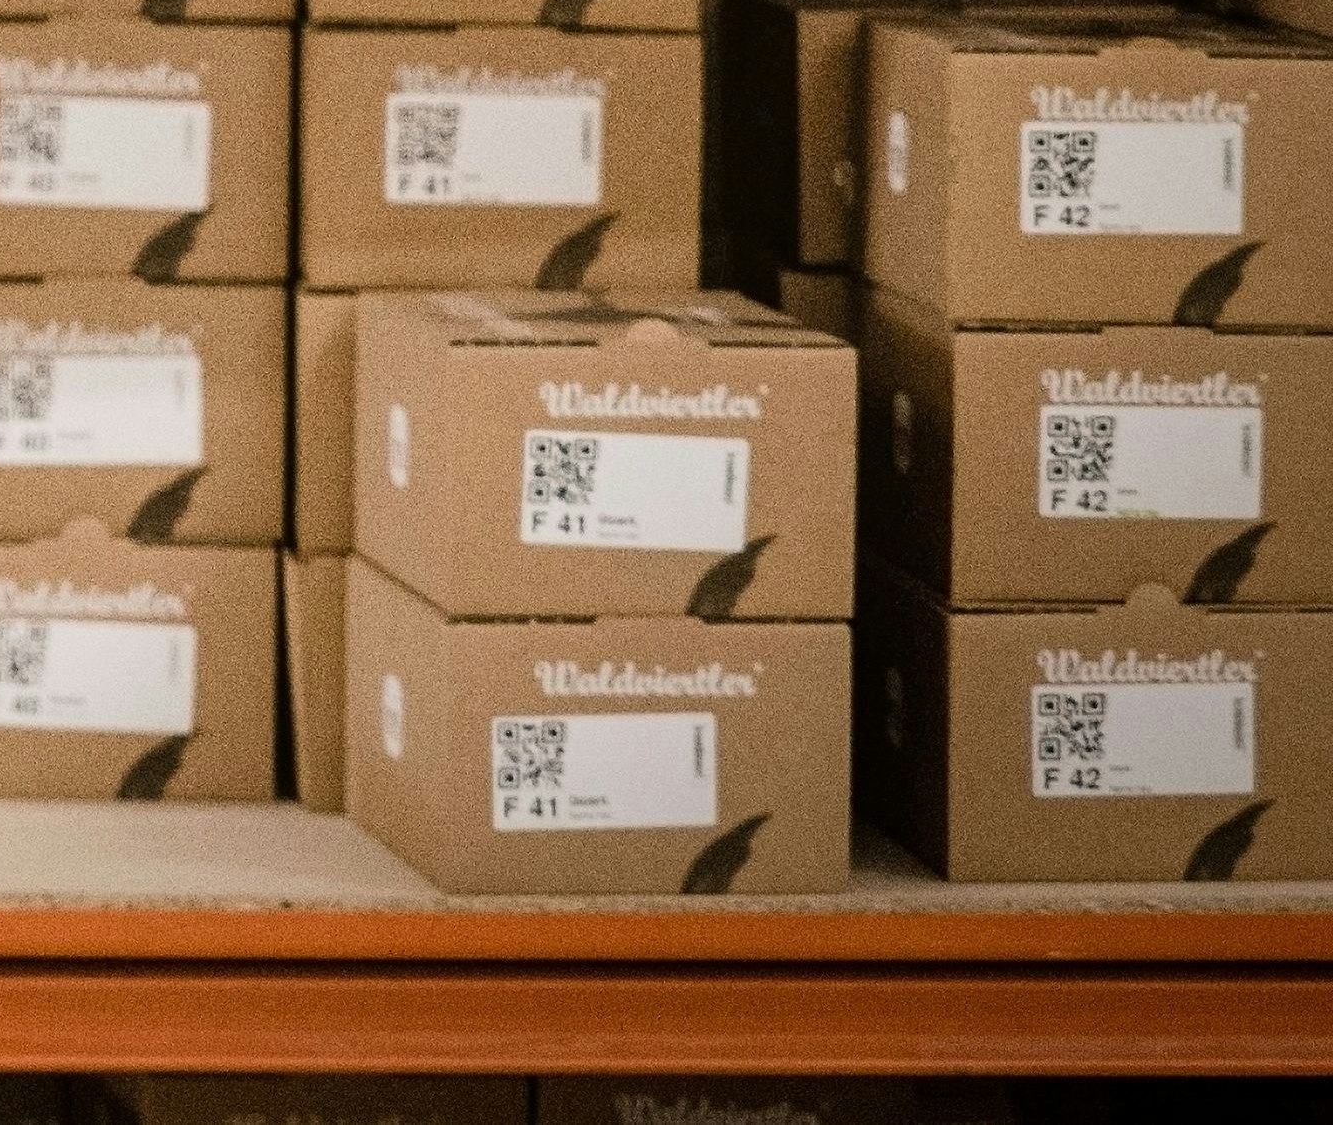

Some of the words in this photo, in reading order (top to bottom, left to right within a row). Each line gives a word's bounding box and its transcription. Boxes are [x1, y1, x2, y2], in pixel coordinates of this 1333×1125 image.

[1030, 86, 1250, 125] Waldviertler
[1035, 203, 1051, 226] F
[1060, 204, 1091, 227] 42
[539, 382, 762, 418] Waldviertler
[1041, 368, 1263, 408] Waldviertler
[1051, 488, 1068, 512] F
[1076, 488, 1108, 513] 42
[532, 510, 548, 534] F
[558, 512, 586, 535] 41
[535, 660, 757, 698] Waldviertler
[1037, 649, 1259, 684] Waldviertler
[1044, 766, 1061, 790] F
[1069, 766, 1102, 791] 42
[504, 796, 519, 819] F
[530, 795, 559, 818] 41
